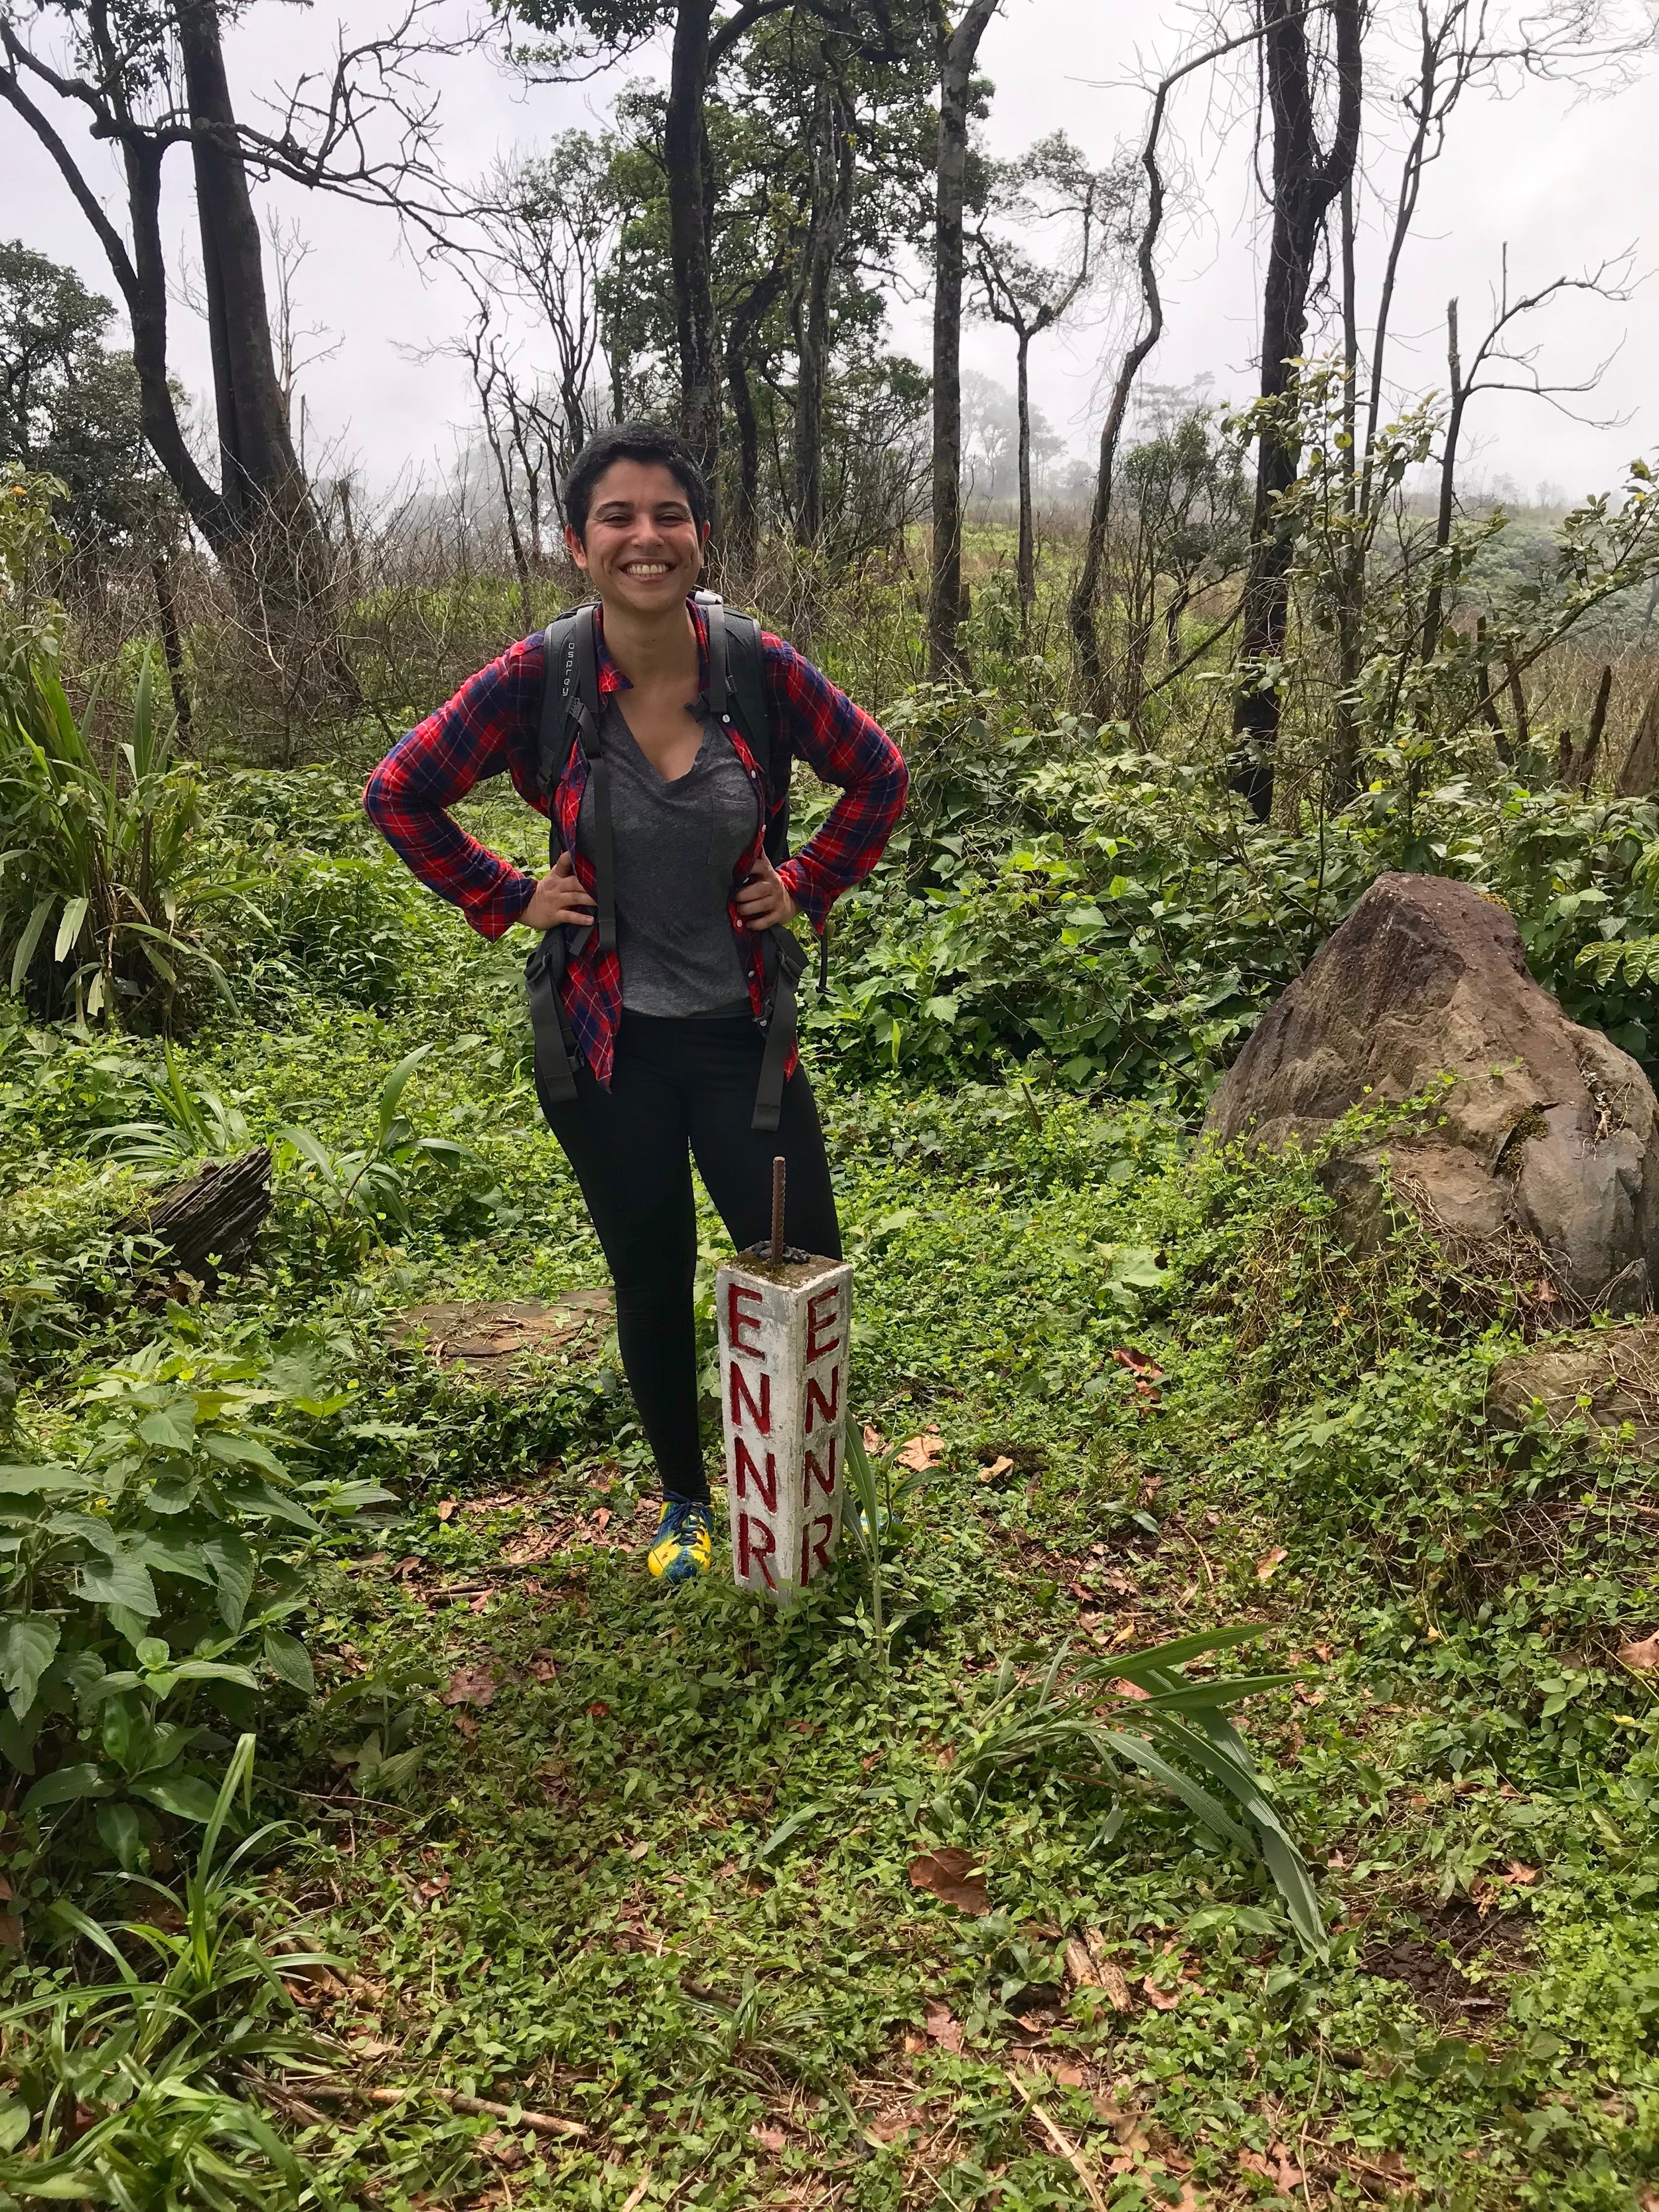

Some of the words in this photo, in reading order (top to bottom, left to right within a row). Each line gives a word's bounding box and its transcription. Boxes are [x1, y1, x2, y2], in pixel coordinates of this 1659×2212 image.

[562, 642, 575, 696] osprey
[728, 1282, 778, 1593] ENNR
[801, 1284, 841, 1588] ENNR
